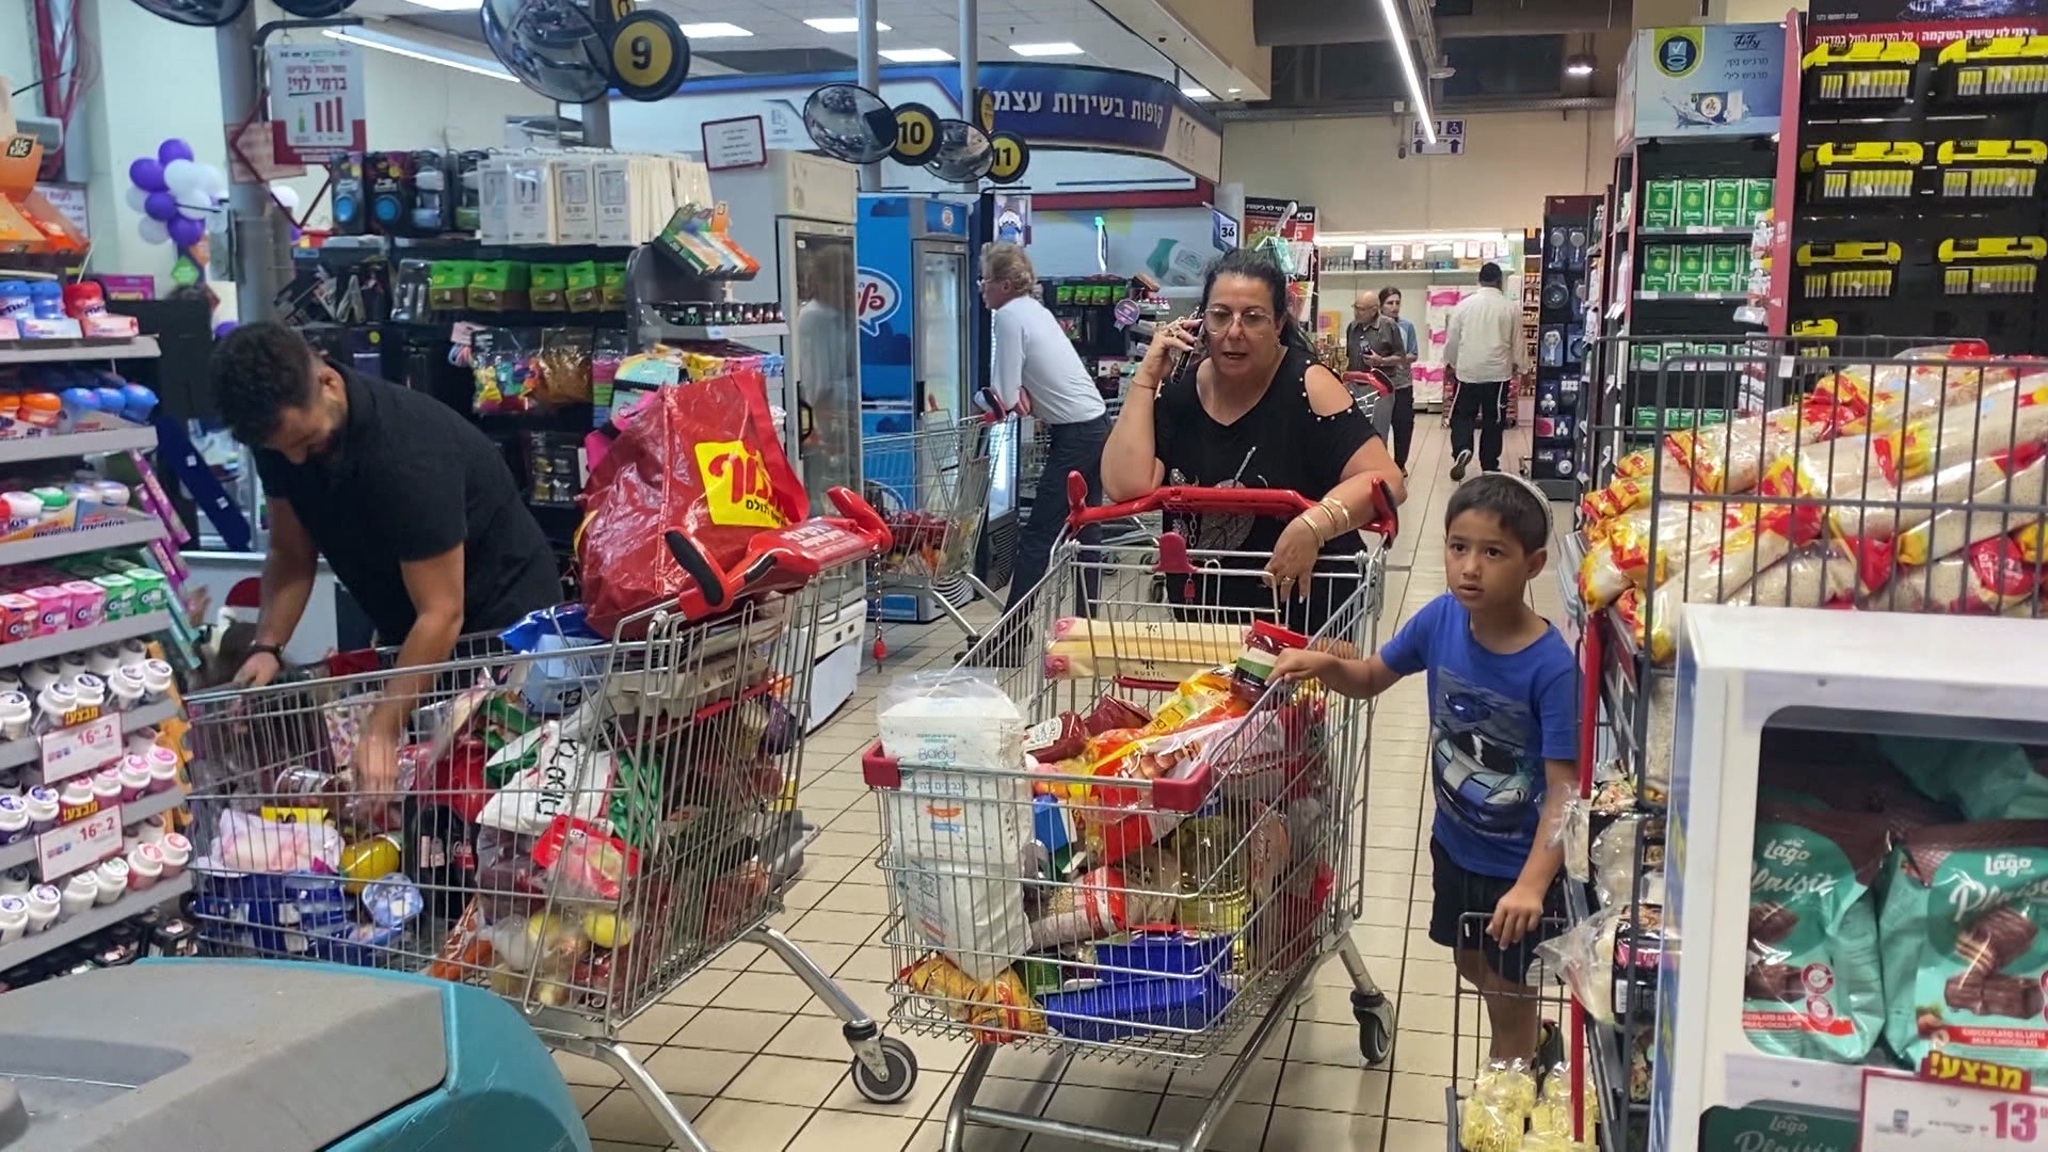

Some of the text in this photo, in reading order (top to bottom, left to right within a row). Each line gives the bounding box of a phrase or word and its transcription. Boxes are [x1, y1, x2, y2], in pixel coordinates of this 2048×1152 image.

[1902, 30, 1914, 42] סל
[1922, 30, 1964, 43] השקמה
[1996, 26, 2010, 37] לוי
[630, 35, 652, 70] 9
[1742, 57, 1769, 66] מרגיש
[1742, 72, 1768, 80] מרגיש
[993, 90, 1043, 114] עצמ
[1052, 92, 1126, 119] בשירות
[1130, 100, 1164, 129] קופות
[897, 121, 925, 145] 10
[995, 147, 1012, 167] 11
[1221, 227, 1235, 238] 36
[81, 518, 126, 532] mentos
[65, 706, 99, 725] מבצע!
[104, 725, 113, 738] 2
[918, 746, 957, 763] Baby
[63, 800, 99, 822] מבצע!
[107, 816, 115, 831] 2
[1763, 838, 1811, 866] Lago
[1985, 854, 2033, 878] Lago
[1930, 1052, 2023, 1091] מבצע!
[1768, 1114, 1808, 1136] Lago
[1990, 1101, 2038, 1143] 13
